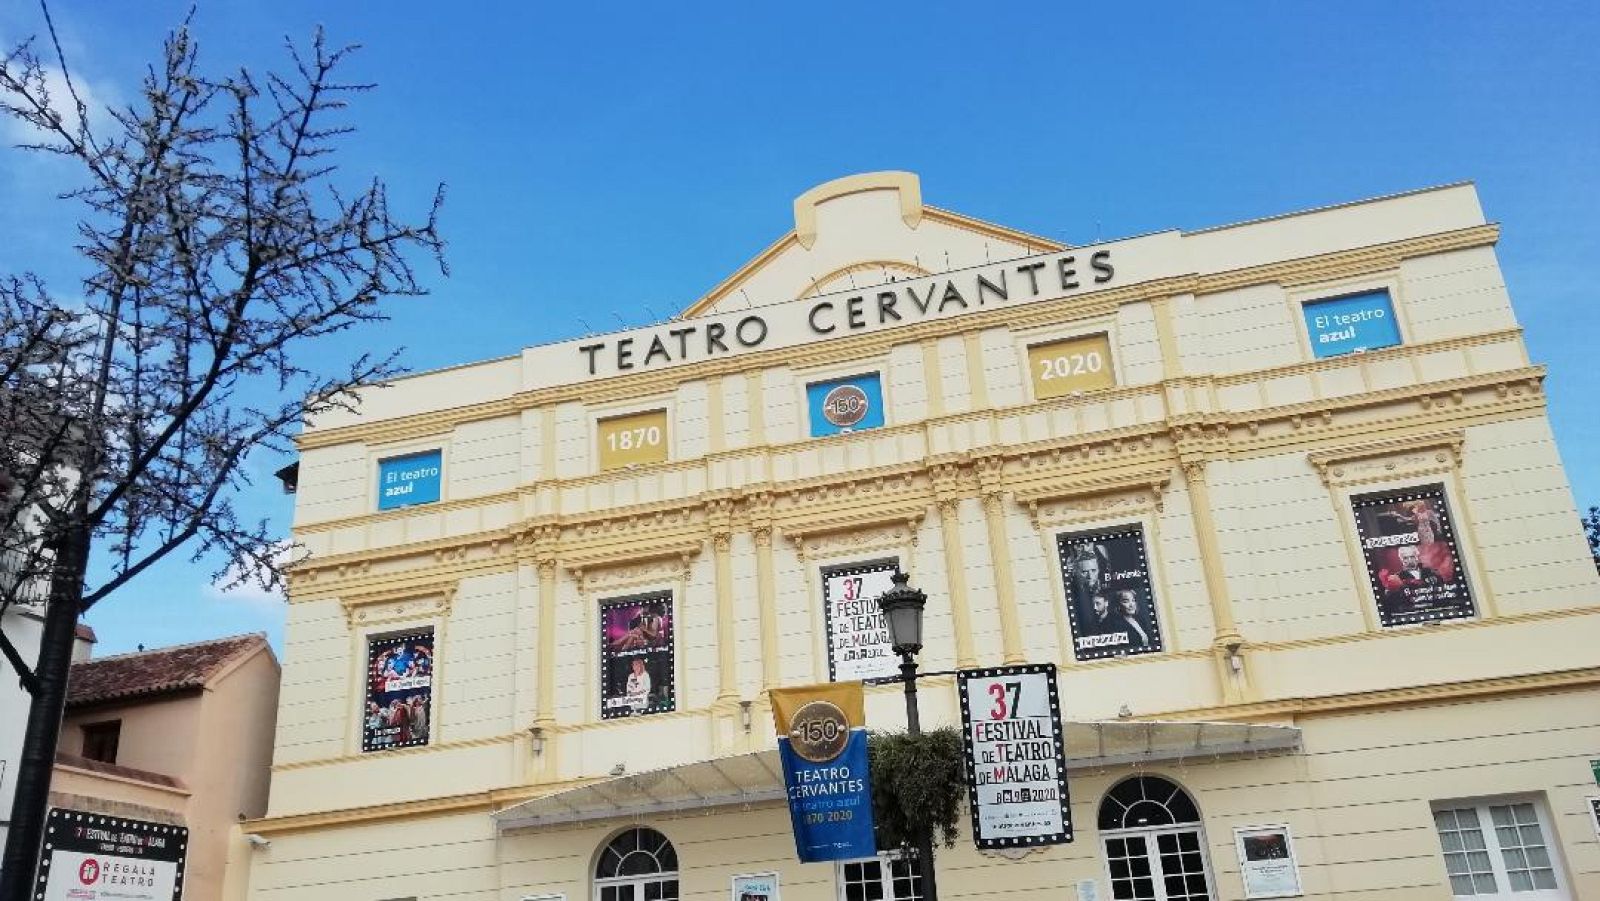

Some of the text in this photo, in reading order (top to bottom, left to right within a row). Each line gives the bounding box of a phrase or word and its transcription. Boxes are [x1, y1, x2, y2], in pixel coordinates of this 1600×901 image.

[579, 250, 1115, 375] TEATRO CERVANTES
[1315, 309, 1385, 328] El teatro
[1319, 325, 1356, 343] azul
[1039, 352, 1102, 380] 2020
[832, 396, 860, 414] 150
[606, 426, 660, 451] 1870
[385, 467, 438, 483] El teatro
[385, 481, 413, 497] azul
[842, 577, 863, 600] 37
[850, 614, 887, 632] TEATR
[988, 682, 1022, 720] 37
[800, 720, 838, 743] 150
[975, 720, 1047, 743] FESTIVAL
[982, 741, 1052, 763] DE TEATRO
[795, 767, 850, 783] TEATRO
[978, 762, 1051, 785] DE MÁLAGA
[788, 779, 864, 800] CERVANTES
[1032, 788, 1056, 802] 2020
[836, 794, 860, 808] azul
[828, 810, 853, 822] 2020
[102, 862, 155, 876] REGALA
[102, 873, 154, 888] TEATRO
